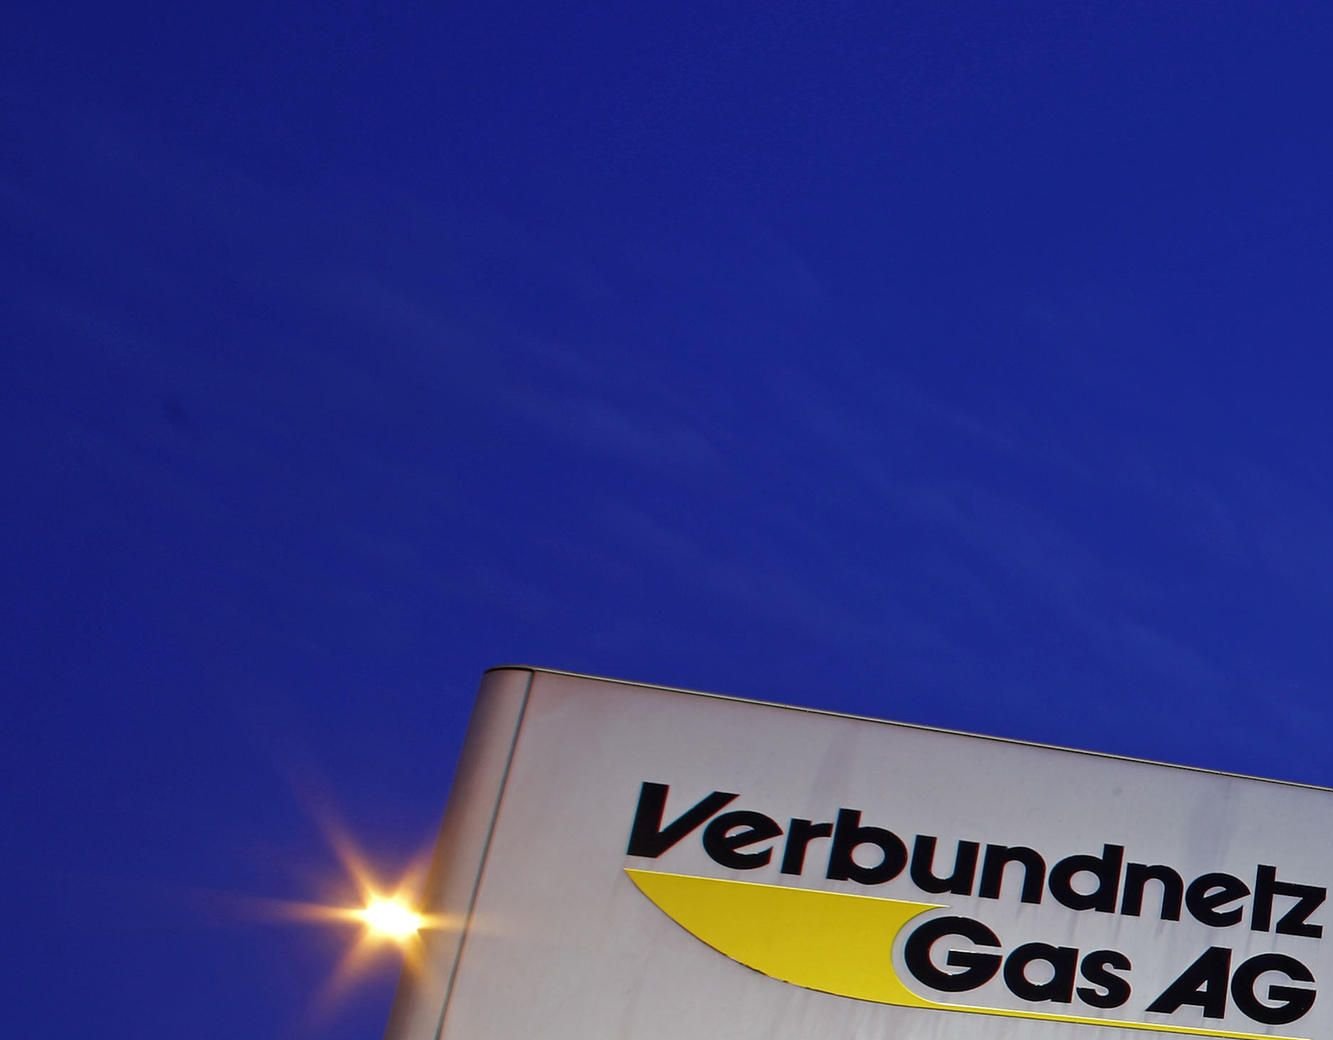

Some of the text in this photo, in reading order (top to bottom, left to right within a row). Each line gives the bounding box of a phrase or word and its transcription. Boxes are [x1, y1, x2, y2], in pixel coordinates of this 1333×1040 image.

[625, 782, 1327, 939] Verbundnetz
[903, 915, 1317, 1025] Gas AG
